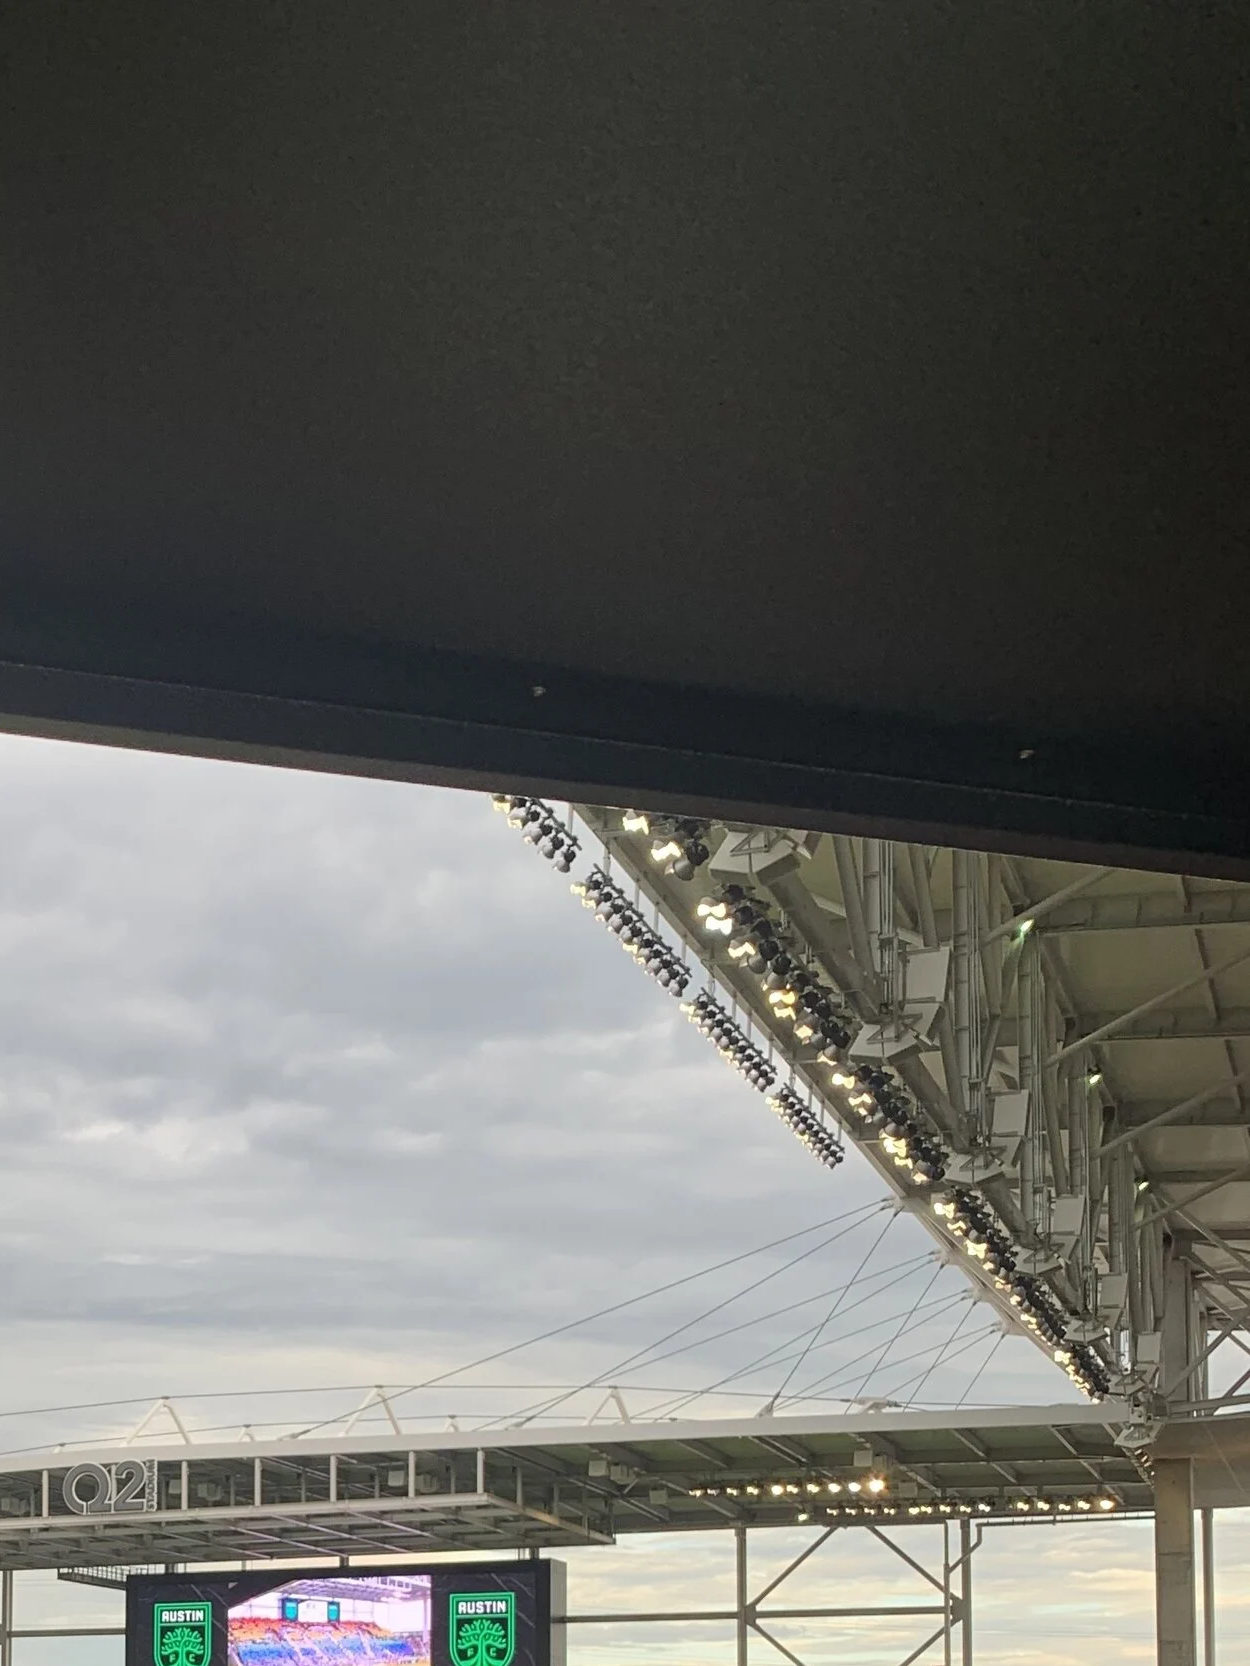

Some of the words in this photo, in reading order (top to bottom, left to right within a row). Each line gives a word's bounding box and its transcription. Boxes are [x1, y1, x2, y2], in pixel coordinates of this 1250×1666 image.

[62, 1459, 146, 1515] Q2
[457, 1600, 507, 1614] AUSTIN
[161, 1609, 204, 1622] AUSTIN
